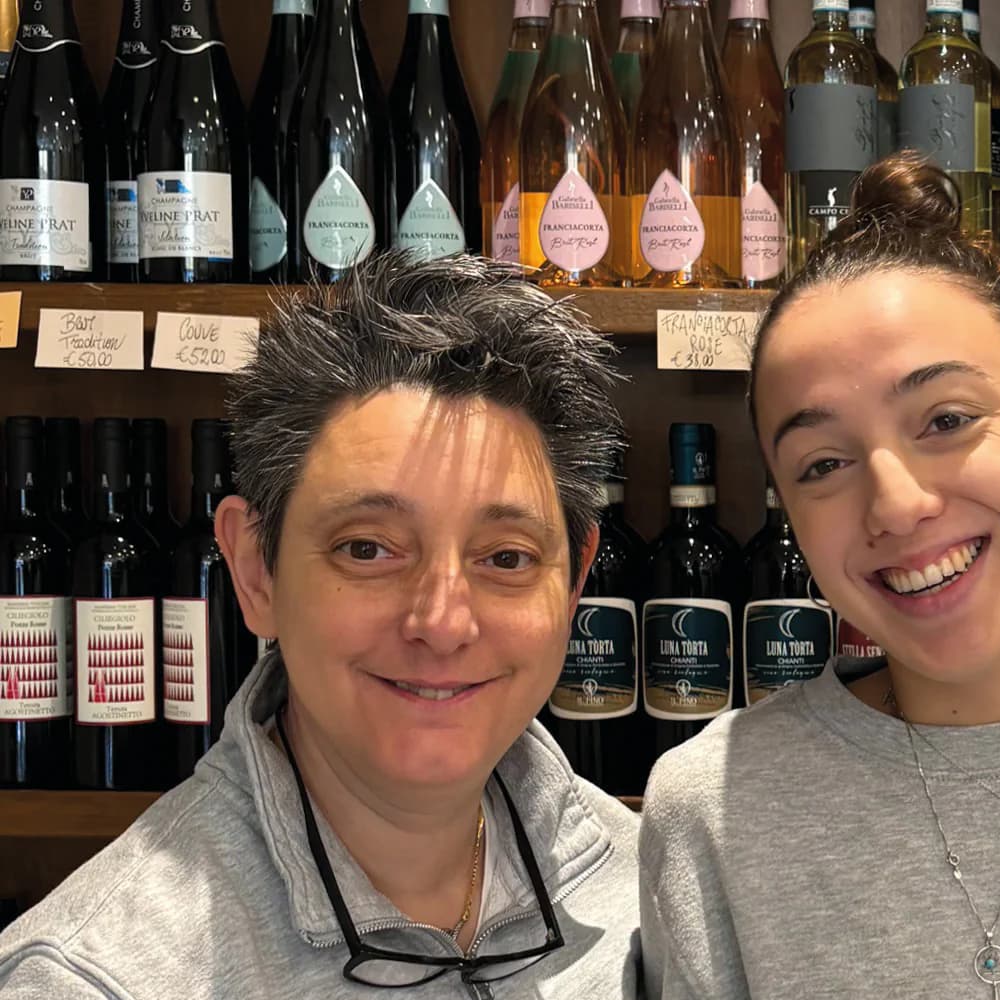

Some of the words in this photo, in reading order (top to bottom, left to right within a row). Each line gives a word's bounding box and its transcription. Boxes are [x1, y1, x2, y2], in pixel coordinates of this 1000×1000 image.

[185, 210, 220, 223] PRAT
[808, 208, 838, 216] CAMPO
[40, 218, 76, 232] PRAT
[308, 221, 369, 230] FRANCIACORTA
[543, 224, 603, 232] FRANCIACORTA
[643, 224, 698, 233] FRANCIACORTA
[400, 232, 460, 241] FRANCIACORTA
[568, 639, 586, 655] UNA
[660, 639, 680, 655] LUNA
[766, 640, 788, 656] LUNA
